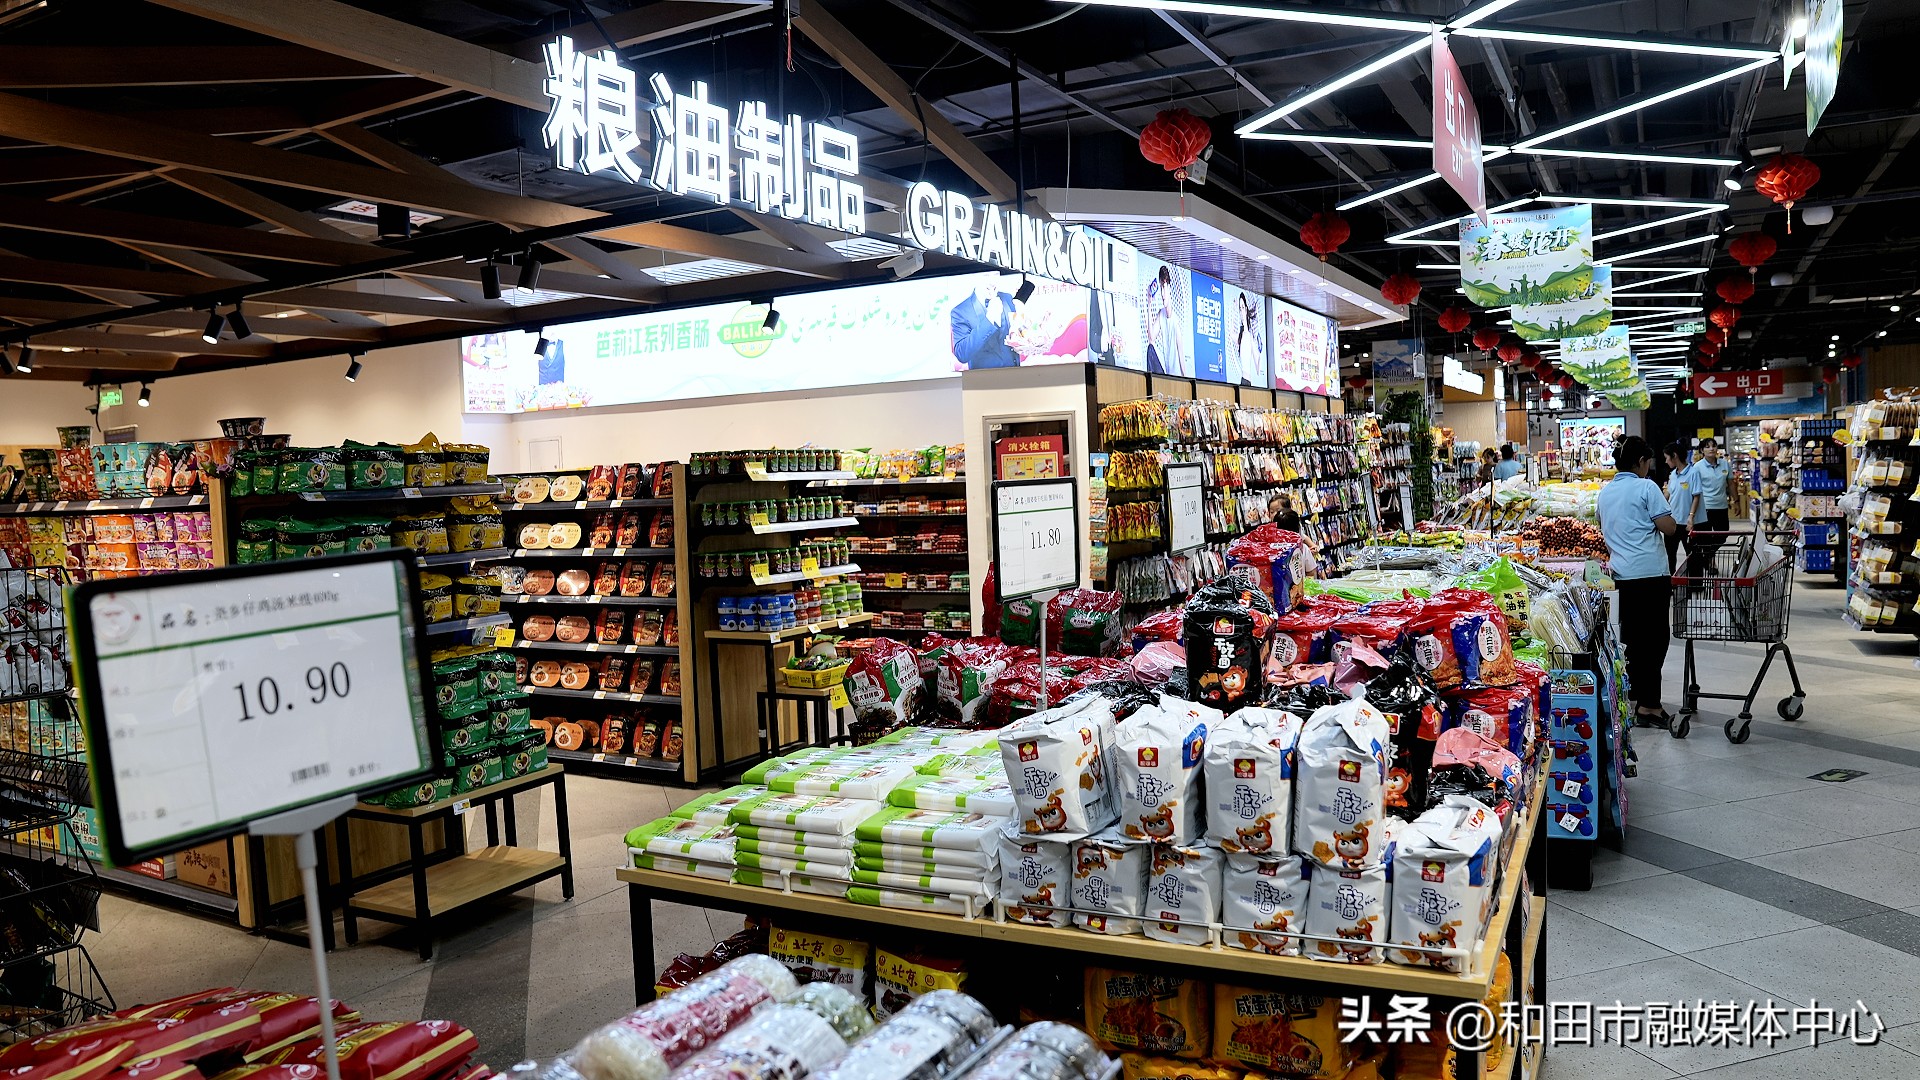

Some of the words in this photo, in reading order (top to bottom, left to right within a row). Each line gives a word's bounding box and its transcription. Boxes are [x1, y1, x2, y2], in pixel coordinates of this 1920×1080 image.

[1444, 69, 1467, 151] 出口
[543, 35, 865, 234] 粮油制品
[1452, 144, 1464, 181] EXIT
[1482, 227, 1572, 261] 春暖花开
[1737, 374, 1771, 388] 出口
[1008, 441, 1051, 452] 消火栓箱
[1031, 527, 1061, 550] 11.80
[1214, 637, 1235, 669] 干吃面
[233, 661, 352, 723] 10.90
[1024, 767, 1049, 800] 干吃面
[1138, 773, 1163, 807] 干吃面
[1235, 785, 1261, 820] 干吃面
[1336, 787, 1361, 824] 干吃面
[1022, 856, 1043, 888] 干吃面
[1256, 880, 1281, 915] 干吃面
[1338, 884, 1364, 920] 干吃面
[1421, 887, 1448, 925] 干吃面
[770, 951, 814, 966] 麻辣方便面
[792, 938, 825, 958] 北京
[891, 964, 918, 987] 北京
